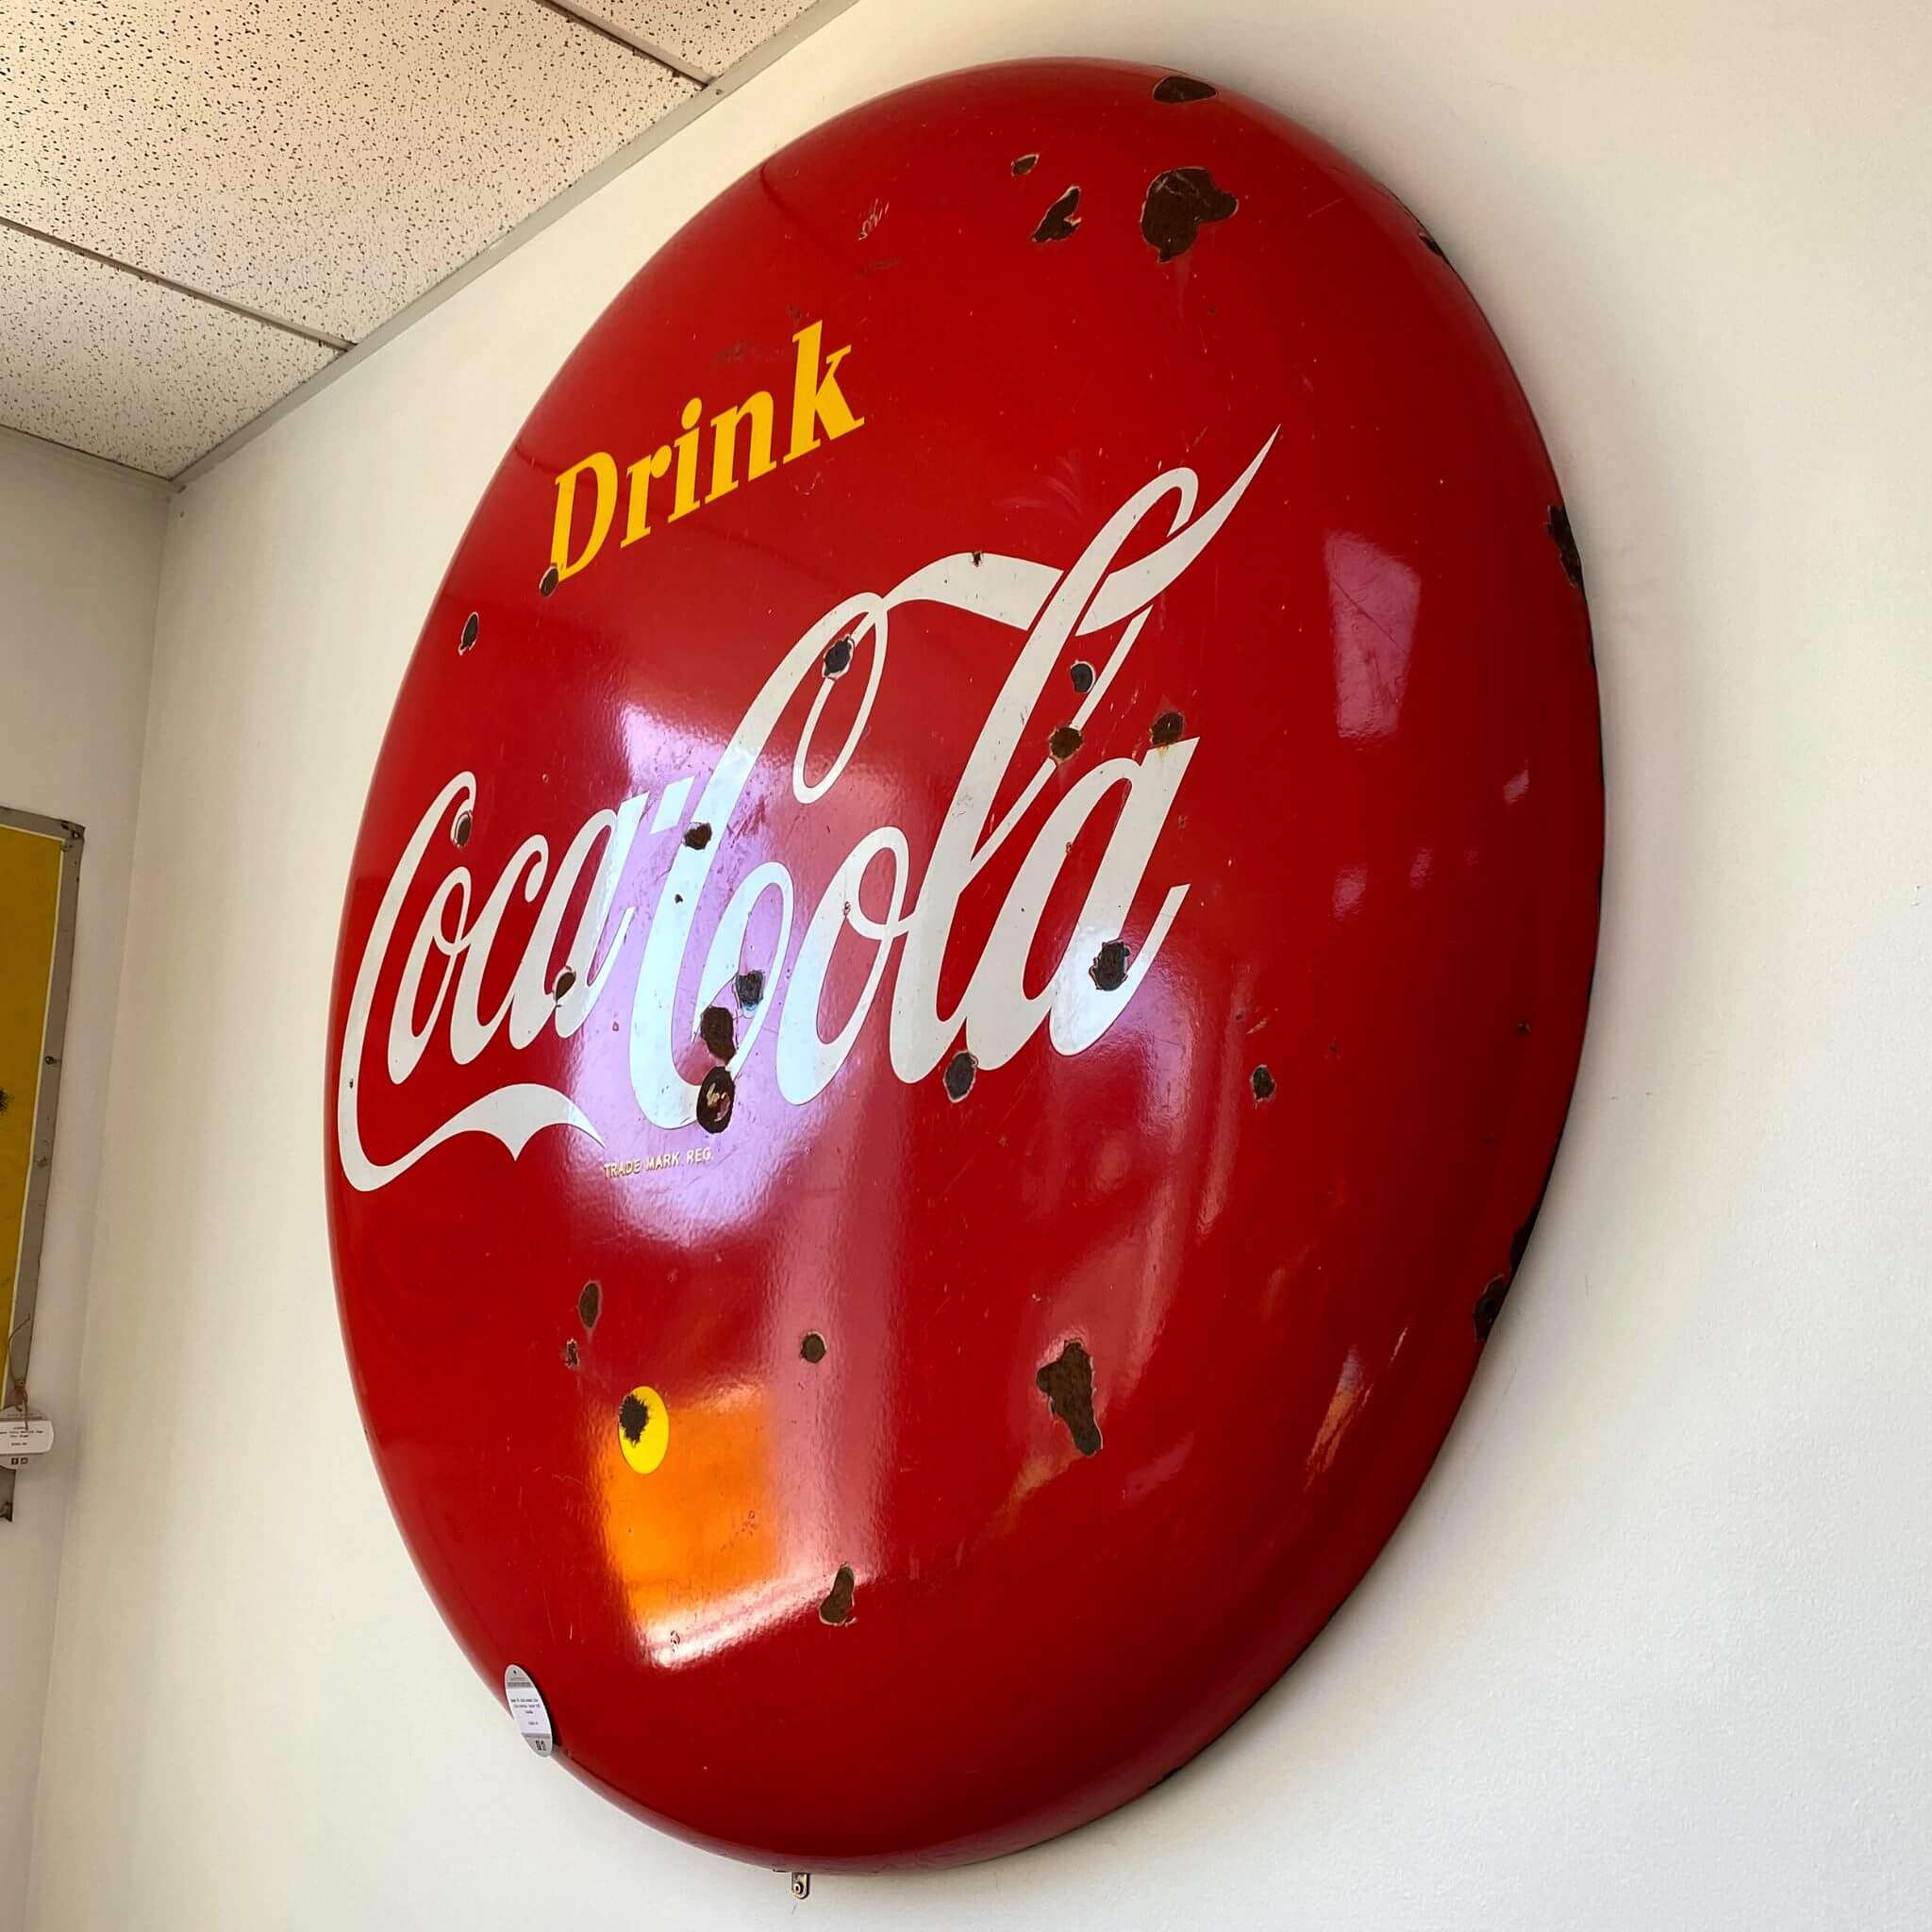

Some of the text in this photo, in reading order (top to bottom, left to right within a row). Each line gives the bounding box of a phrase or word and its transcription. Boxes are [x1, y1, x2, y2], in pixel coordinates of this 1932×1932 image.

[549, 320, 865, 582] Drink
[338, 425, 1280, 1191] Coca-Cola
[604, 1159, 641, 1178] TRADE
[646, 1152, 680, 1172] MARK
